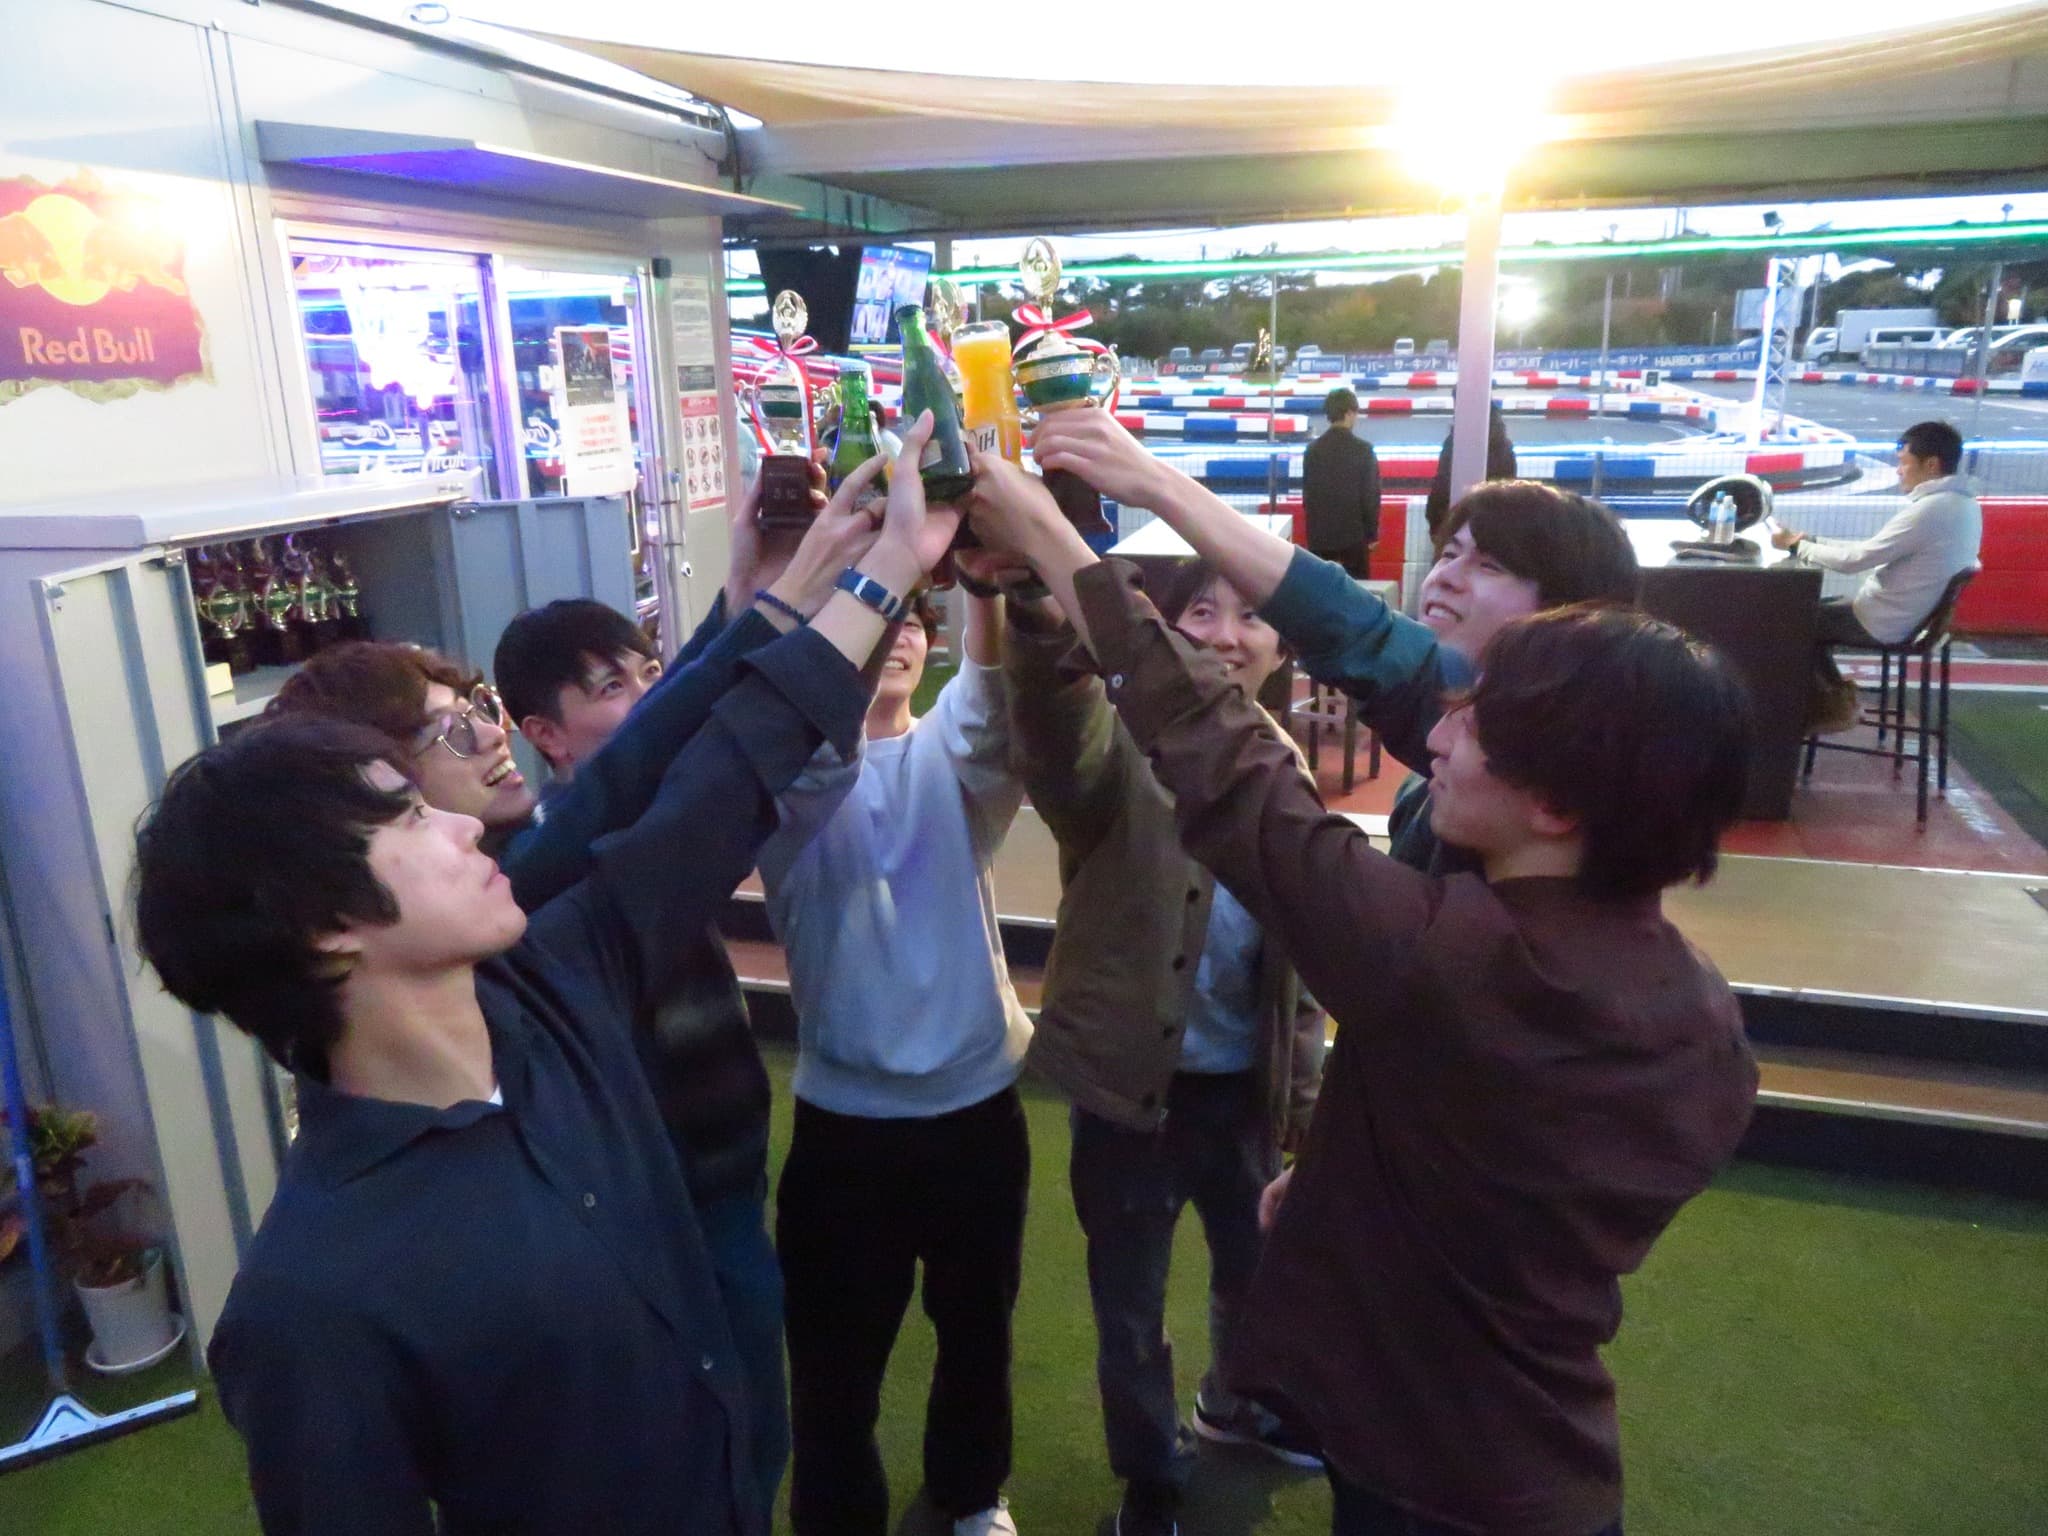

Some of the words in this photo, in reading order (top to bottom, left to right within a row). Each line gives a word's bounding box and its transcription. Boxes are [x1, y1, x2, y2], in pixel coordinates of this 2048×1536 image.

[19, 326, 91, 365] Red
[93, 327, 155, 364] Bull
[1655, 354, 1705, 367] HARBOR
[1711, 351, 1758, 362] CIRCUIT
